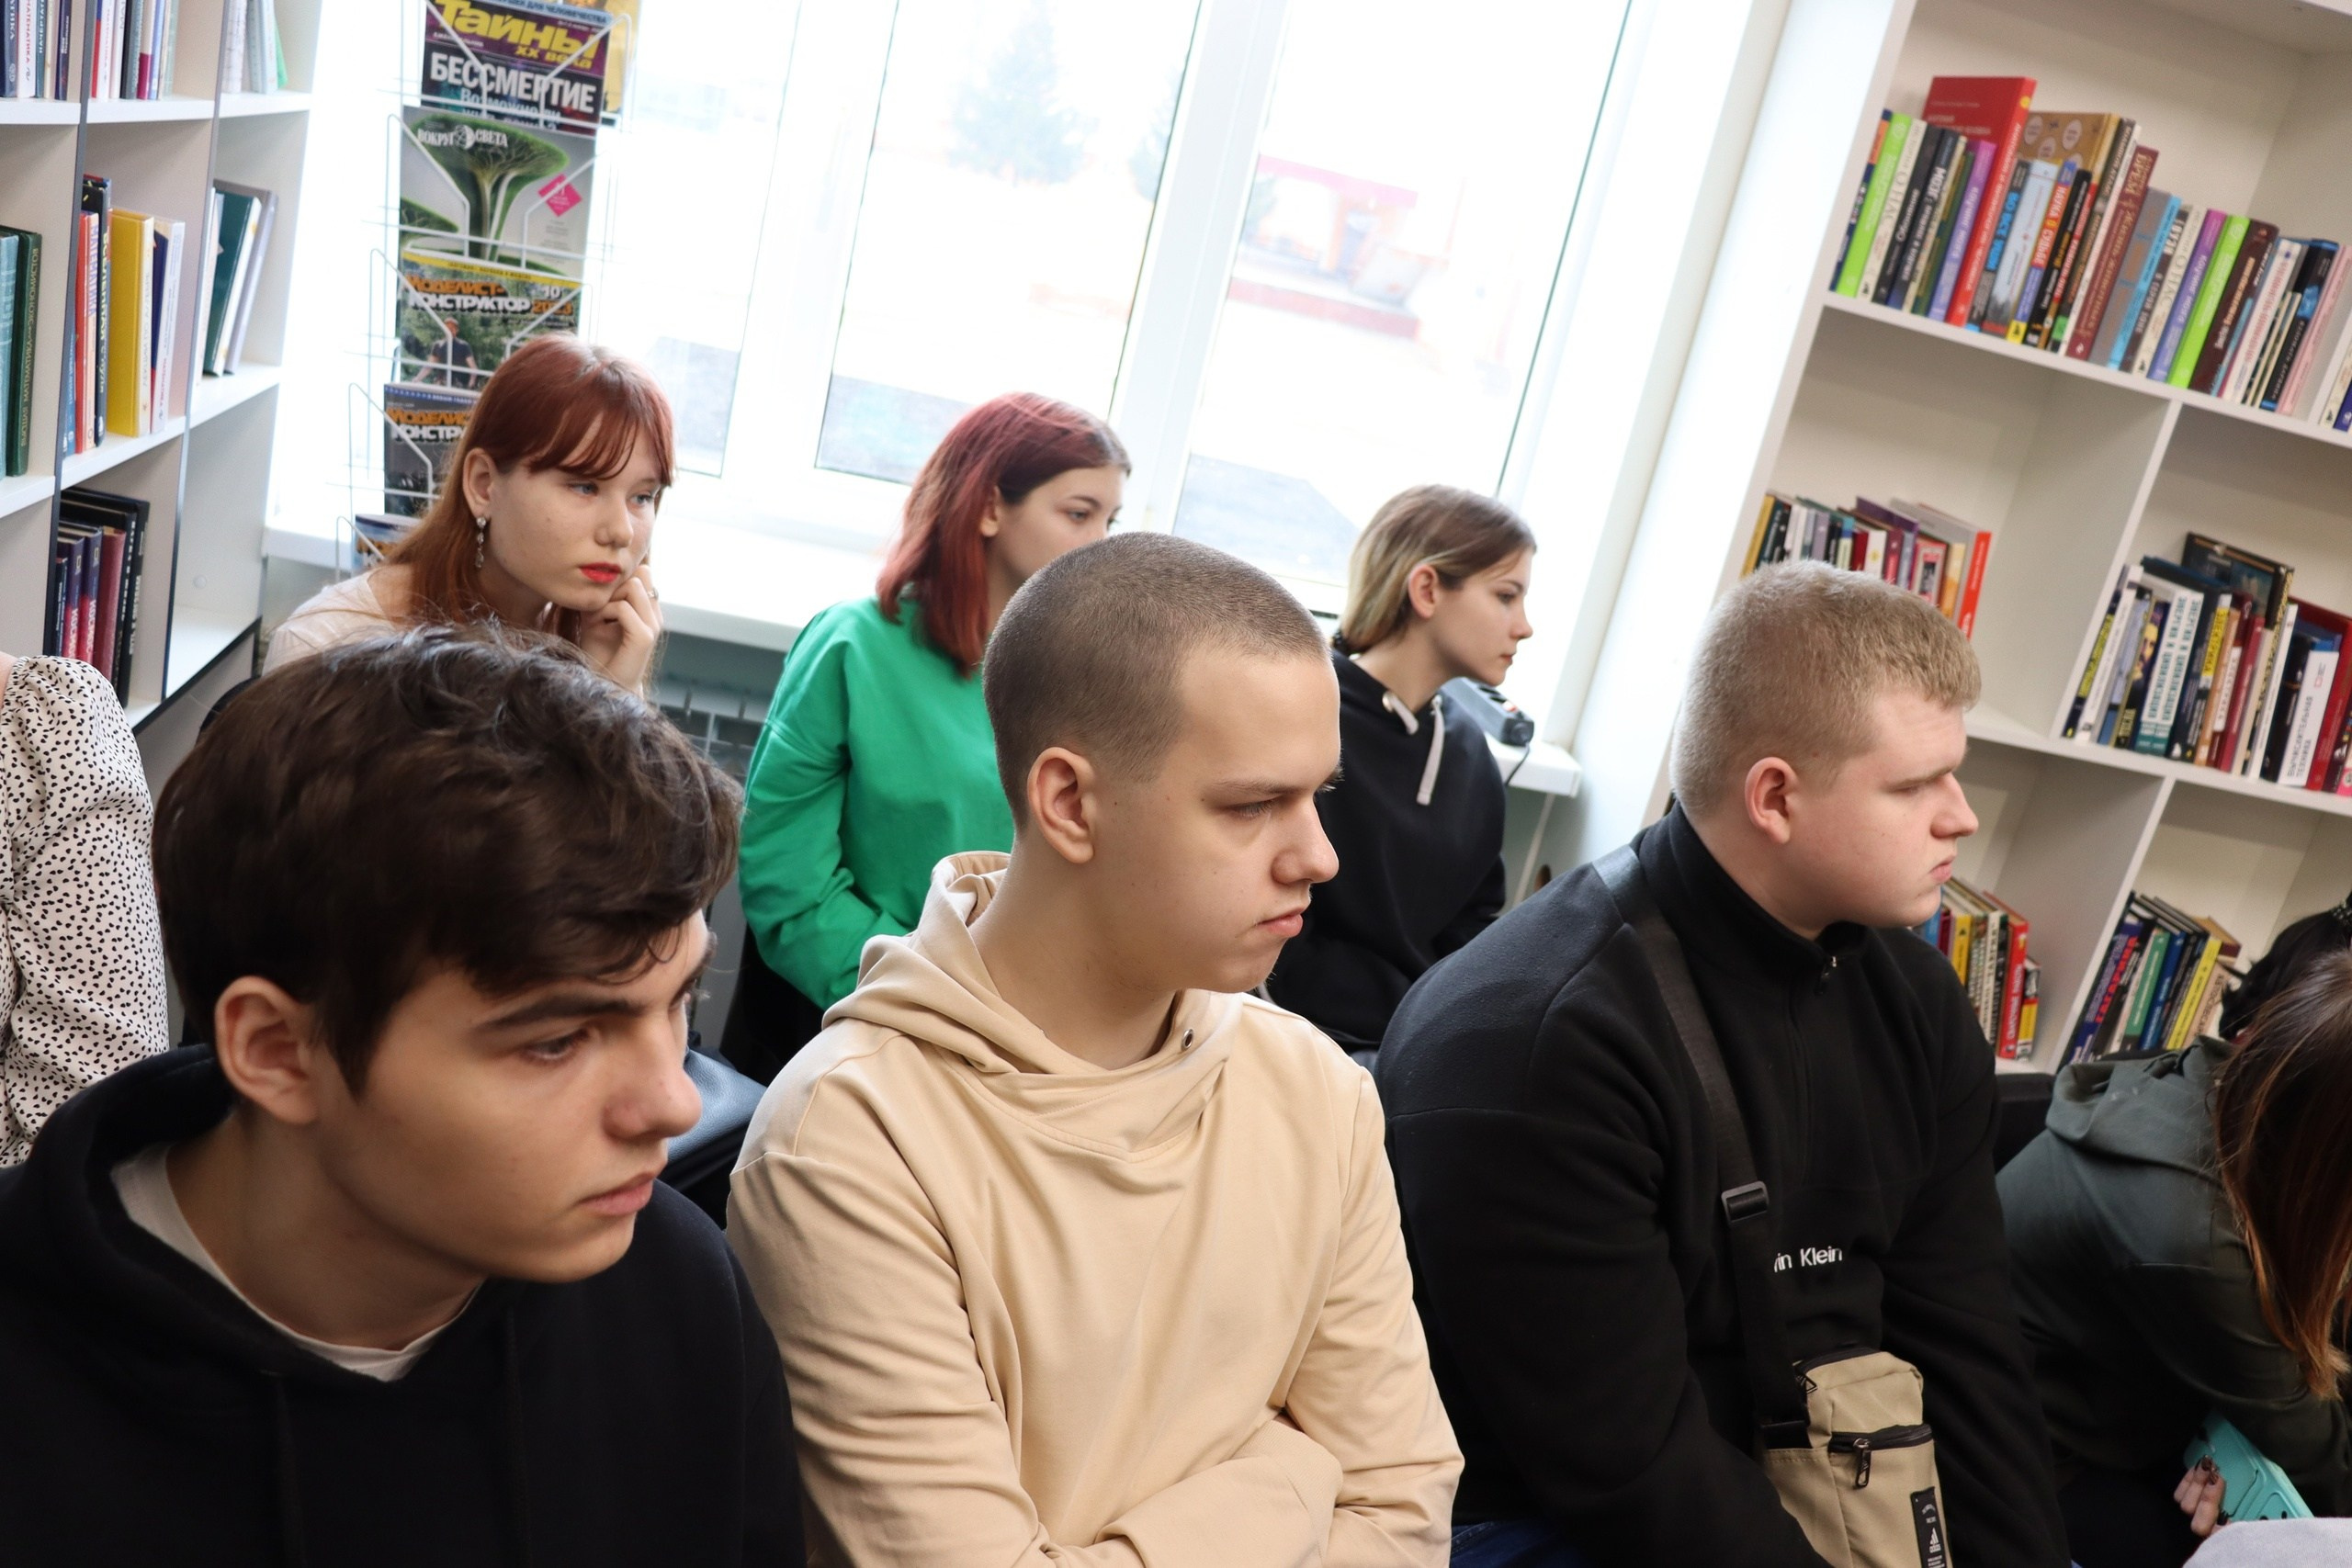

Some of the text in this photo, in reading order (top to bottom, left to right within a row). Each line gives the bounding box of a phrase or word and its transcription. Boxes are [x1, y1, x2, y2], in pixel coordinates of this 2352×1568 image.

[430, 52, 596, 114] БЕССМЕРТИЕ
[416, 128, 509, 148] ВОКРУГ СВЕТА
[2122, 152, 2147, 196] БРЕМ
[2047, 185, 2068, 220] НАУКА
[81, 224, 106, 317] МАТЕМАТИКА
[2032, 227, 2054, 265] СУДЬБЕ
[19, 341, 35, 402] МАТЕМАТИКА
[82, 599, 99, 653] КОСМОС
[2144, 596, 2188, 718] ЭНЕРГИЯ И ЦИВИЛИЗАЦИЯ
[2158, 599, 2200, 721] ЭНЕРГИЯ И ЦИВИЛИЗАЦИЯ
[2283, 694, 2316, 778] ВЫЧИСЛИТЕЛЬНАЯ
[2295, 739, 2312, 778] ТЕХНИКА
[1801, 1246, 1843, 1268] Klein
